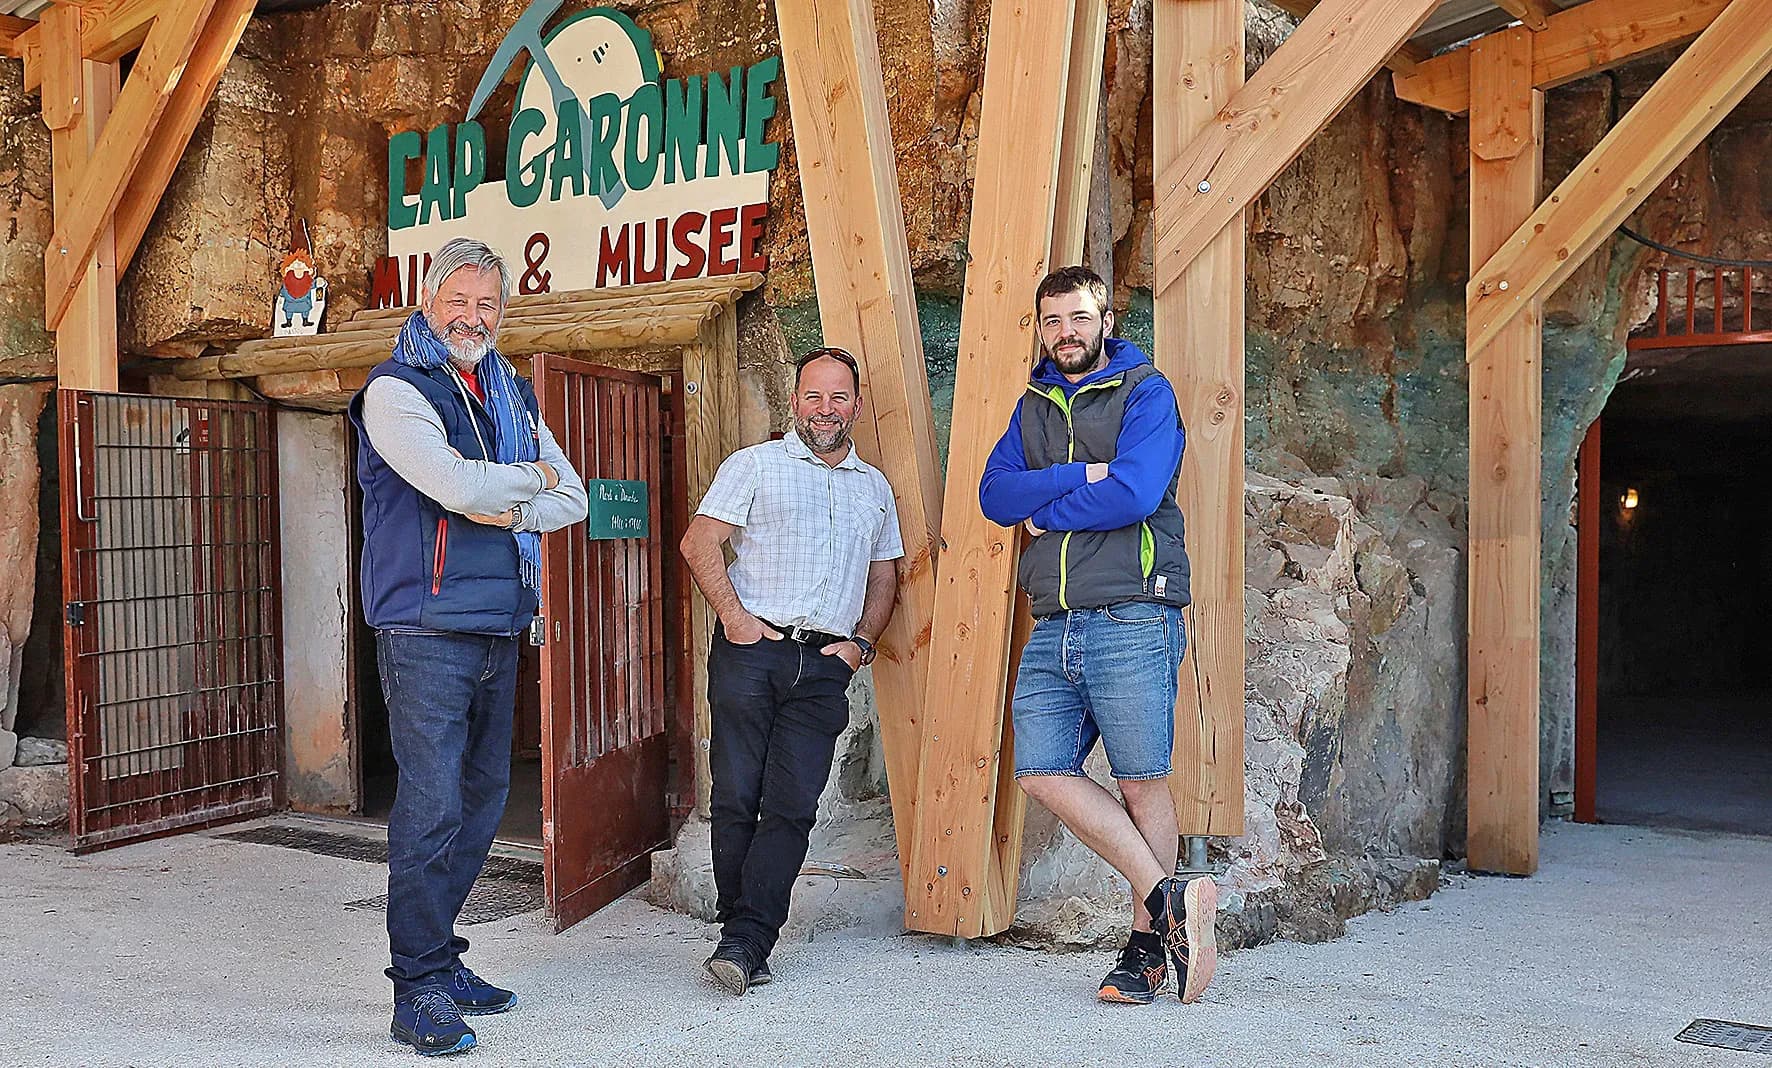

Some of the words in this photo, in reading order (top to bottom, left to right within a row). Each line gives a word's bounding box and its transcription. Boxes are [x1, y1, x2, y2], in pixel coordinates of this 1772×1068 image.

[388, 121, 486, 230] CAP
[505, 56, 780, 208] GARONNE
[519, 232, 552, 295] &
[597, 203, 770, 289] MUSEE
